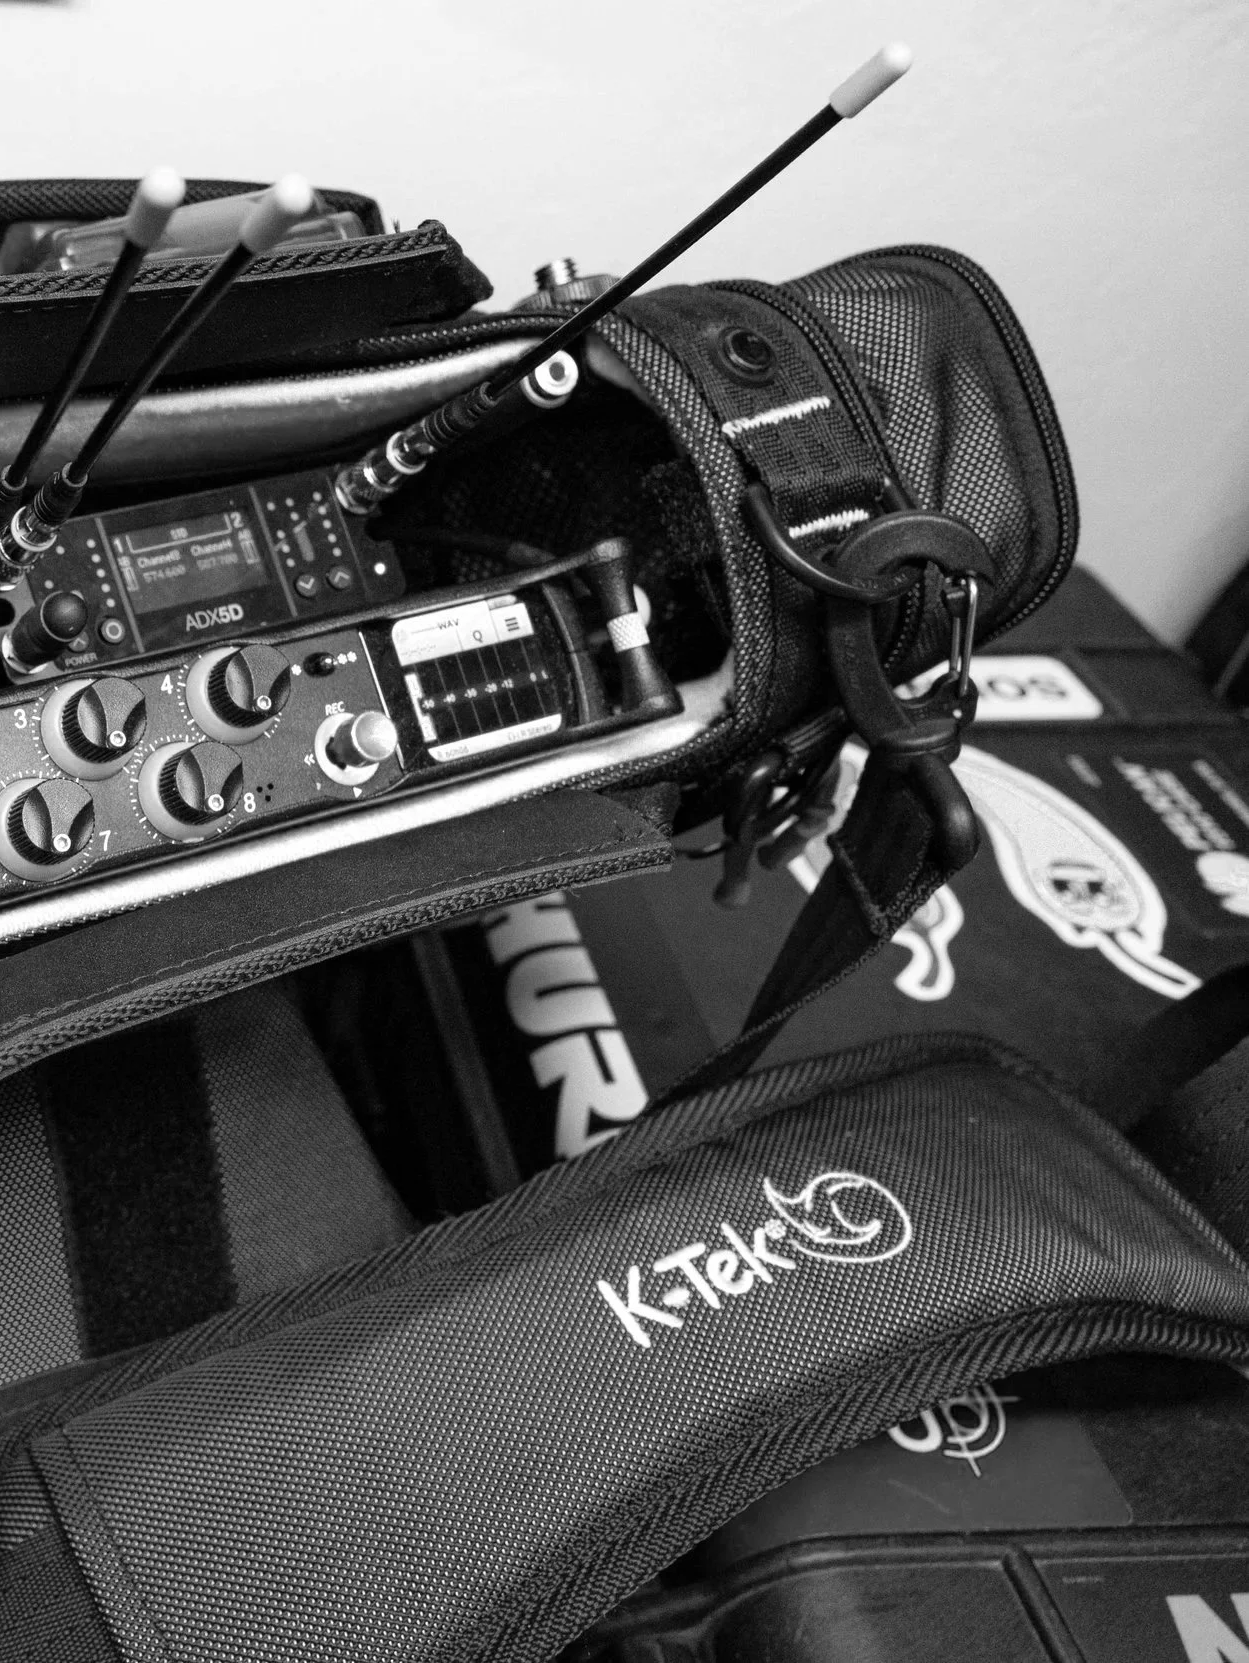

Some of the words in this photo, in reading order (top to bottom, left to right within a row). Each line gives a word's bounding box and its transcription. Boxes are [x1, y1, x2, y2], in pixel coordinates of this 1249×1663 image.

[113, 537, 124, 553] 1
[230, 511, 244, 529] 2
[185, 603, 244, 632] ADX5D
[160, 674, 174, 694] 4
[13, 708, 28, 729] 3
[324, 700, 345, 716] REC
[243, 792, 256, 813] 8
[98, 830, 112, 851] 7
[597, 1222, 796, 1349] K-Tek
